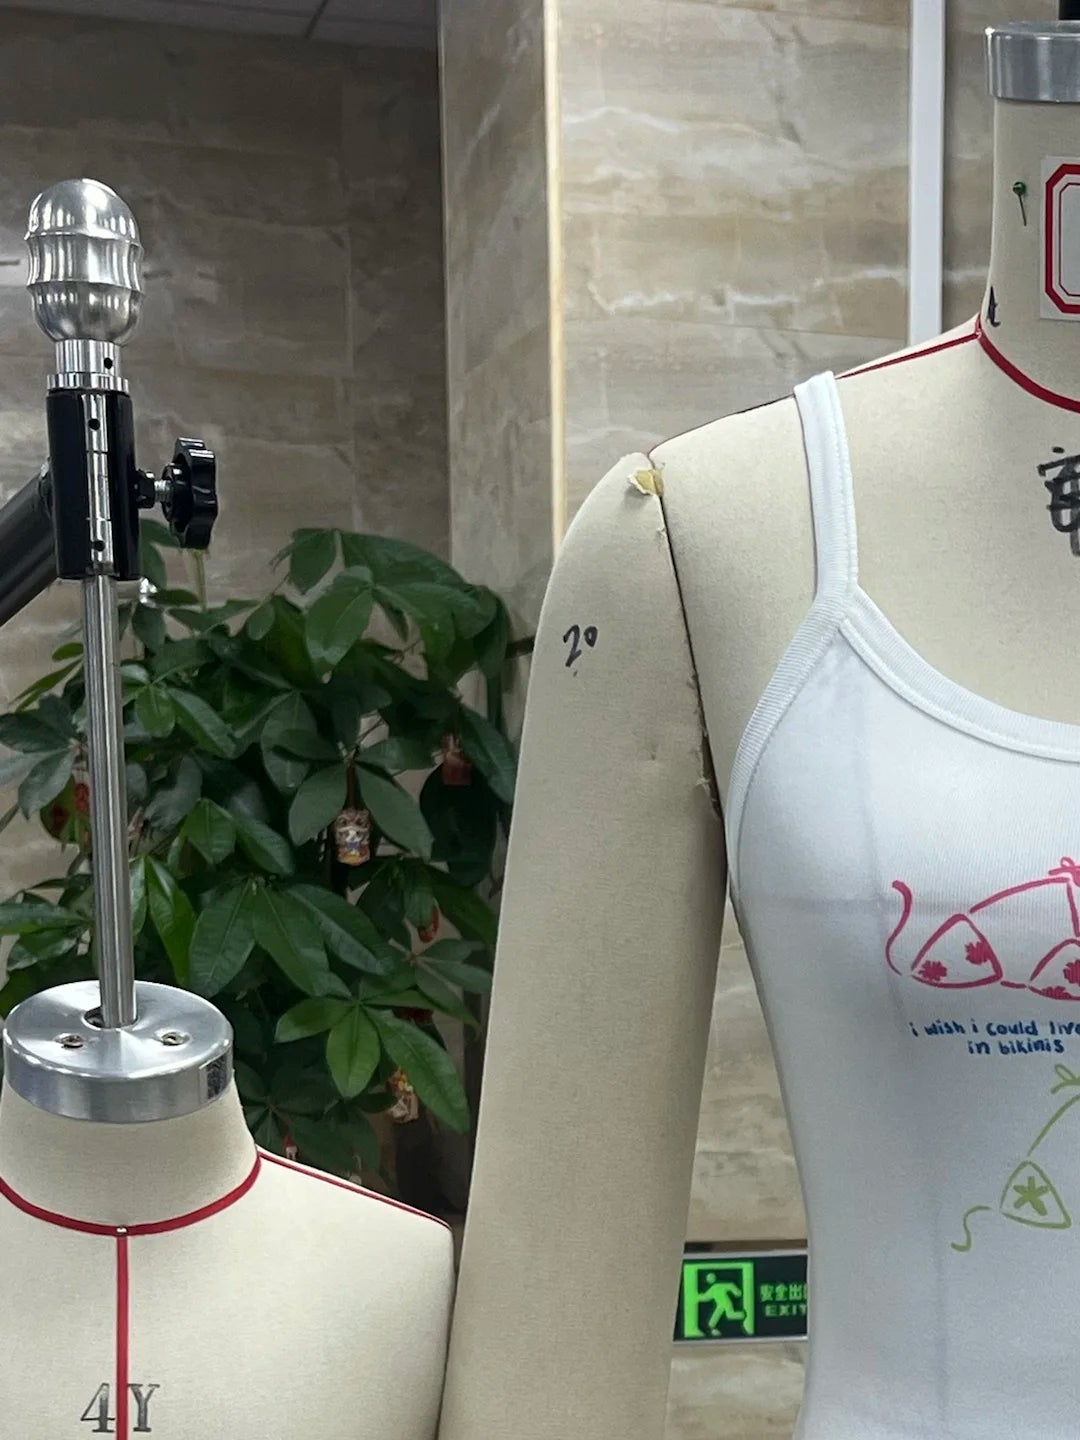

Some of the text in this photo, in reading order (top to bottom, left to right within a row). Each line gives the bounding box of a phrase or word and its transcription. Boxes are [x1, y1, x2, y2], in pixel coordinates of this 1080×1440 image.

[562, 624, 599, 668] 20
[909, 1022, 919, 1037] i
[924, 1018, 965, 1036] wish
[972, 1018, 979, 1034] i
[986, 1020, 1039, 1036] could
[967, 1038, 1065, 1055] in bikinis
[80, 1382, 160, 1433] 4Y
